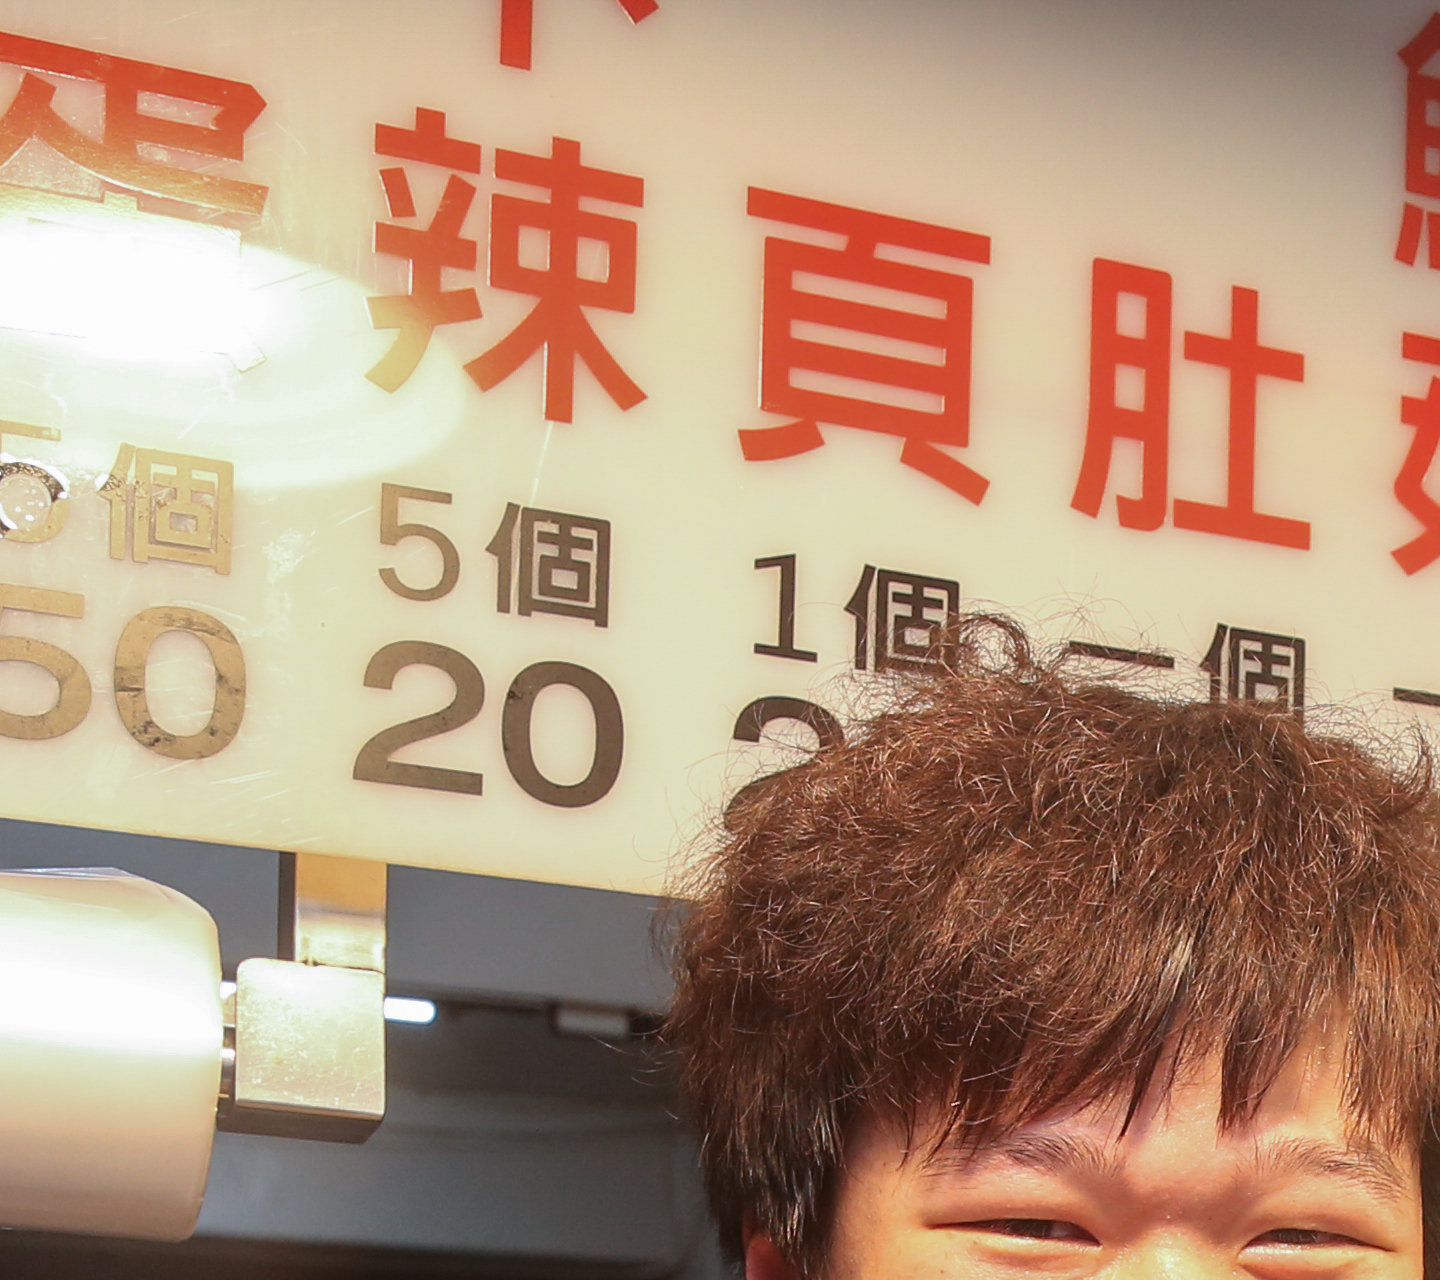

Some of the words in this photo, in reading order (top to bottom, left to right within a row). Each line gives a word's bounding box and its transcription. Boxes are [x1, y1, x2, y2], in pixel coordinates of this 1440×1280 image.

[364, 0, 659, 424] 辣
[738, 186, 991, 506] 頁
[1070, 256, 1312, 552] 肚
[377, 482, 611, 628] 5個
[754, 553, 960, 675] 1個
[353, 640, 624, 808] 20
